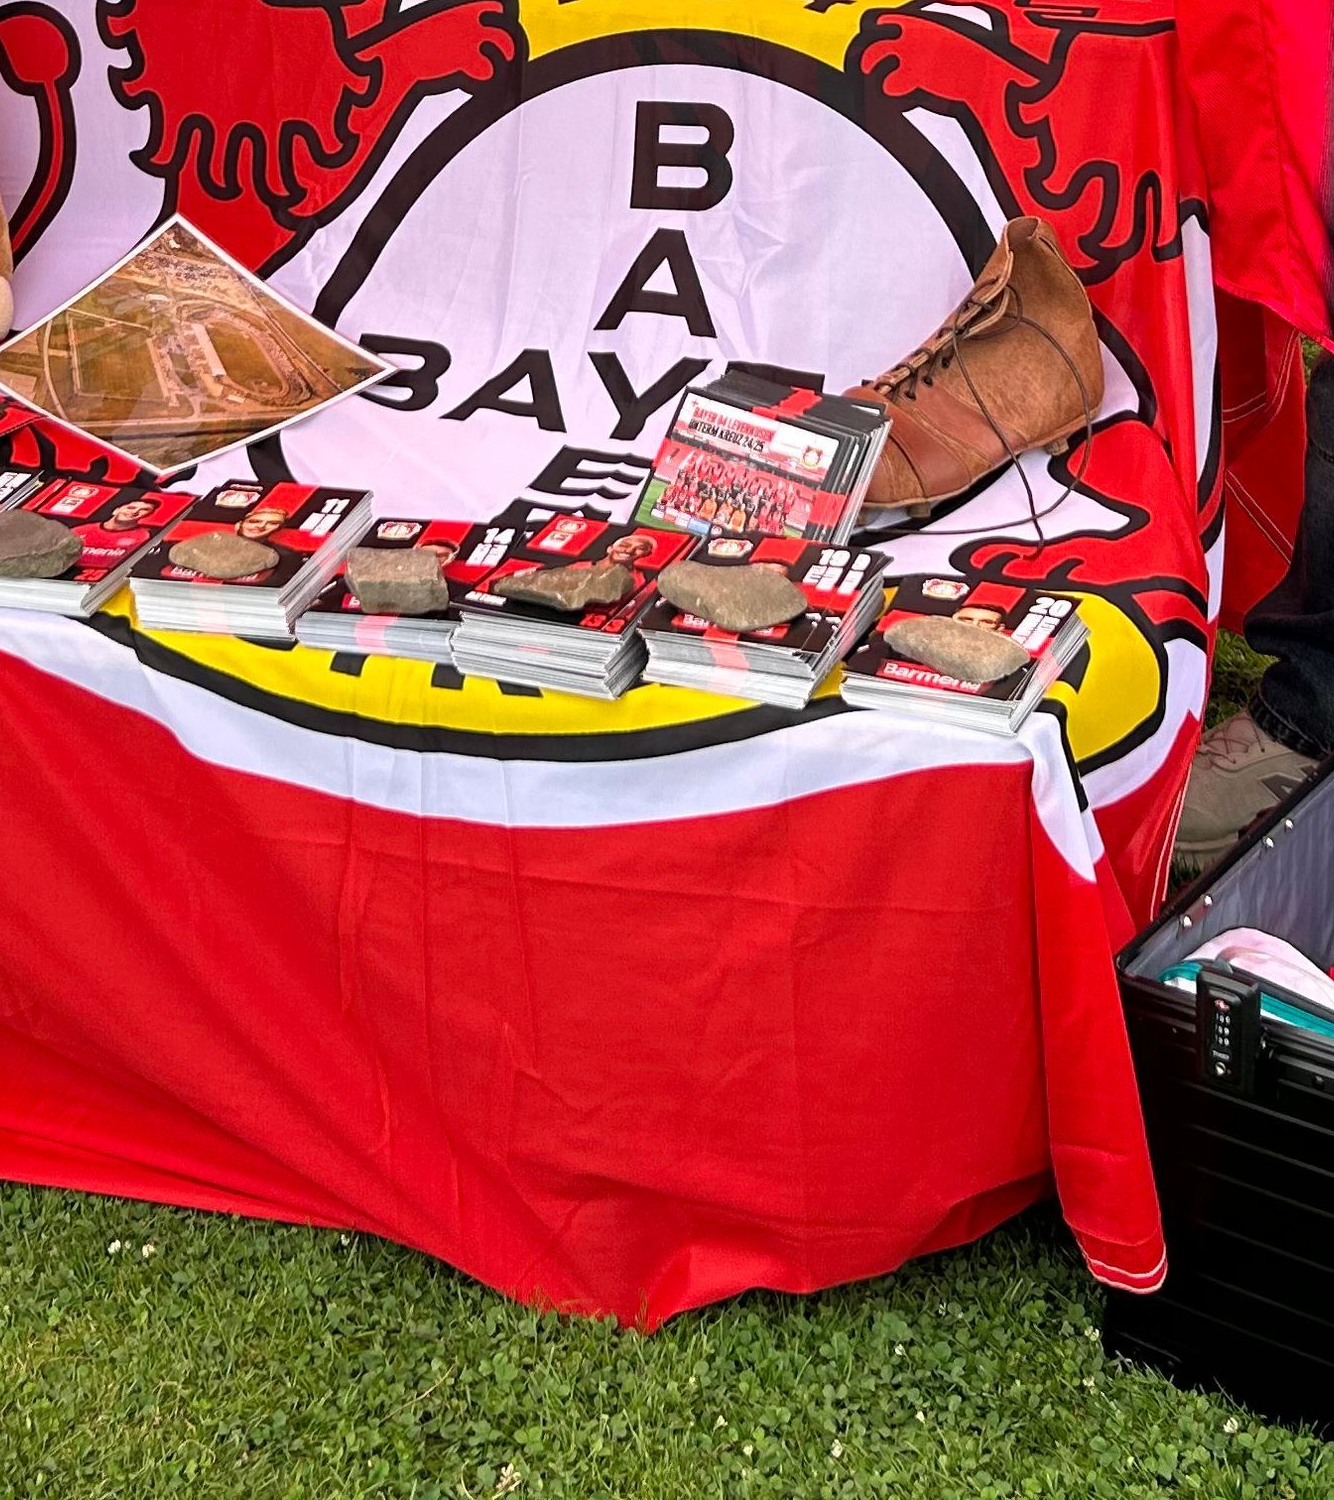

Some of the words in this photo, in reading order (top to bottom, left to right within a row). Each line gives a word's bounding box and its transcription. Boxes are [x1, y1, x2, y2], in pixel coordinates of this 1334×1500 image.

[687, 417, 718, 438] UNTERM
[719, 428, 743, 446] KREUZ
[693, 406, 716, 423] BAYER
[716, 413, 727, 426] 04
[727, 415, 778, 443] LEVERKUSEN
[322, 498, 351, 514] 11
[483, 527, 516, 545] 14
[1028, 596, 1073, 618] 20
